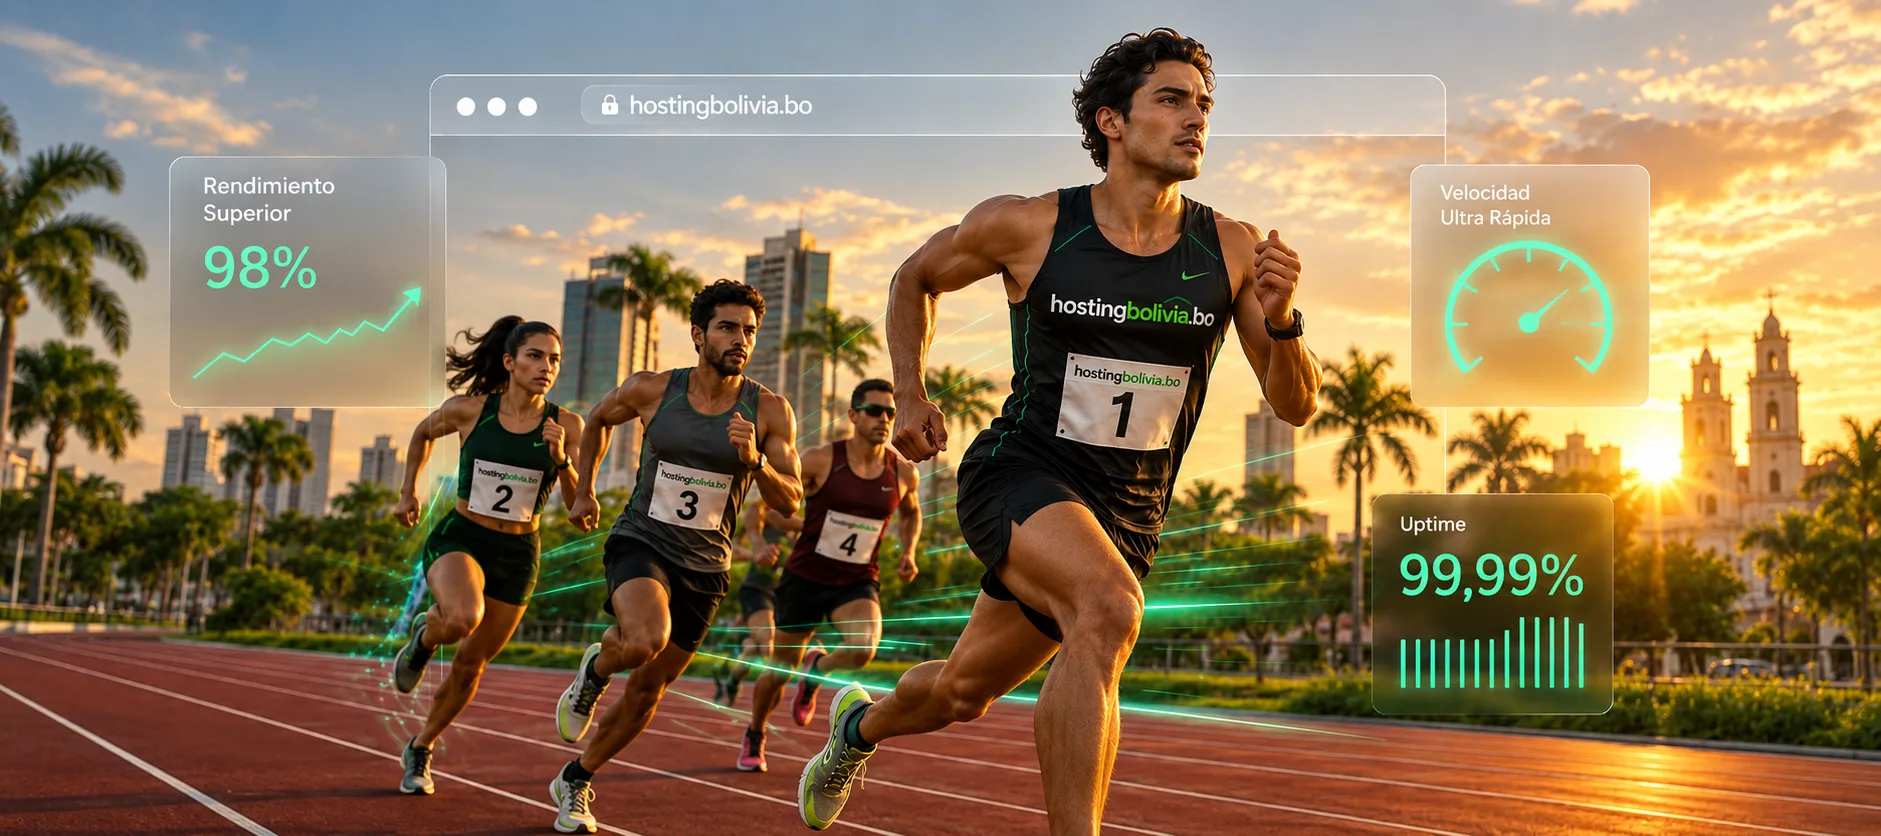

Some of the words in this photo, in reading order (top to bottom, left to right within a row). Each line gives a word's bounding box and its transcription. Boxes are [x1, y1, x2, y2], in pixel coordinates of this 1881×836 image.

[1050, 293, 1215, 327] hostingbolivia.bo
[1074, 364, 1181, 388] hostingbolivia.bo
[1111, 391, 1134, 438] 1
[491, 485, 513, 513] 2
[676, 490, 699, 520] 3
[839, 532, 858, 556] 4
